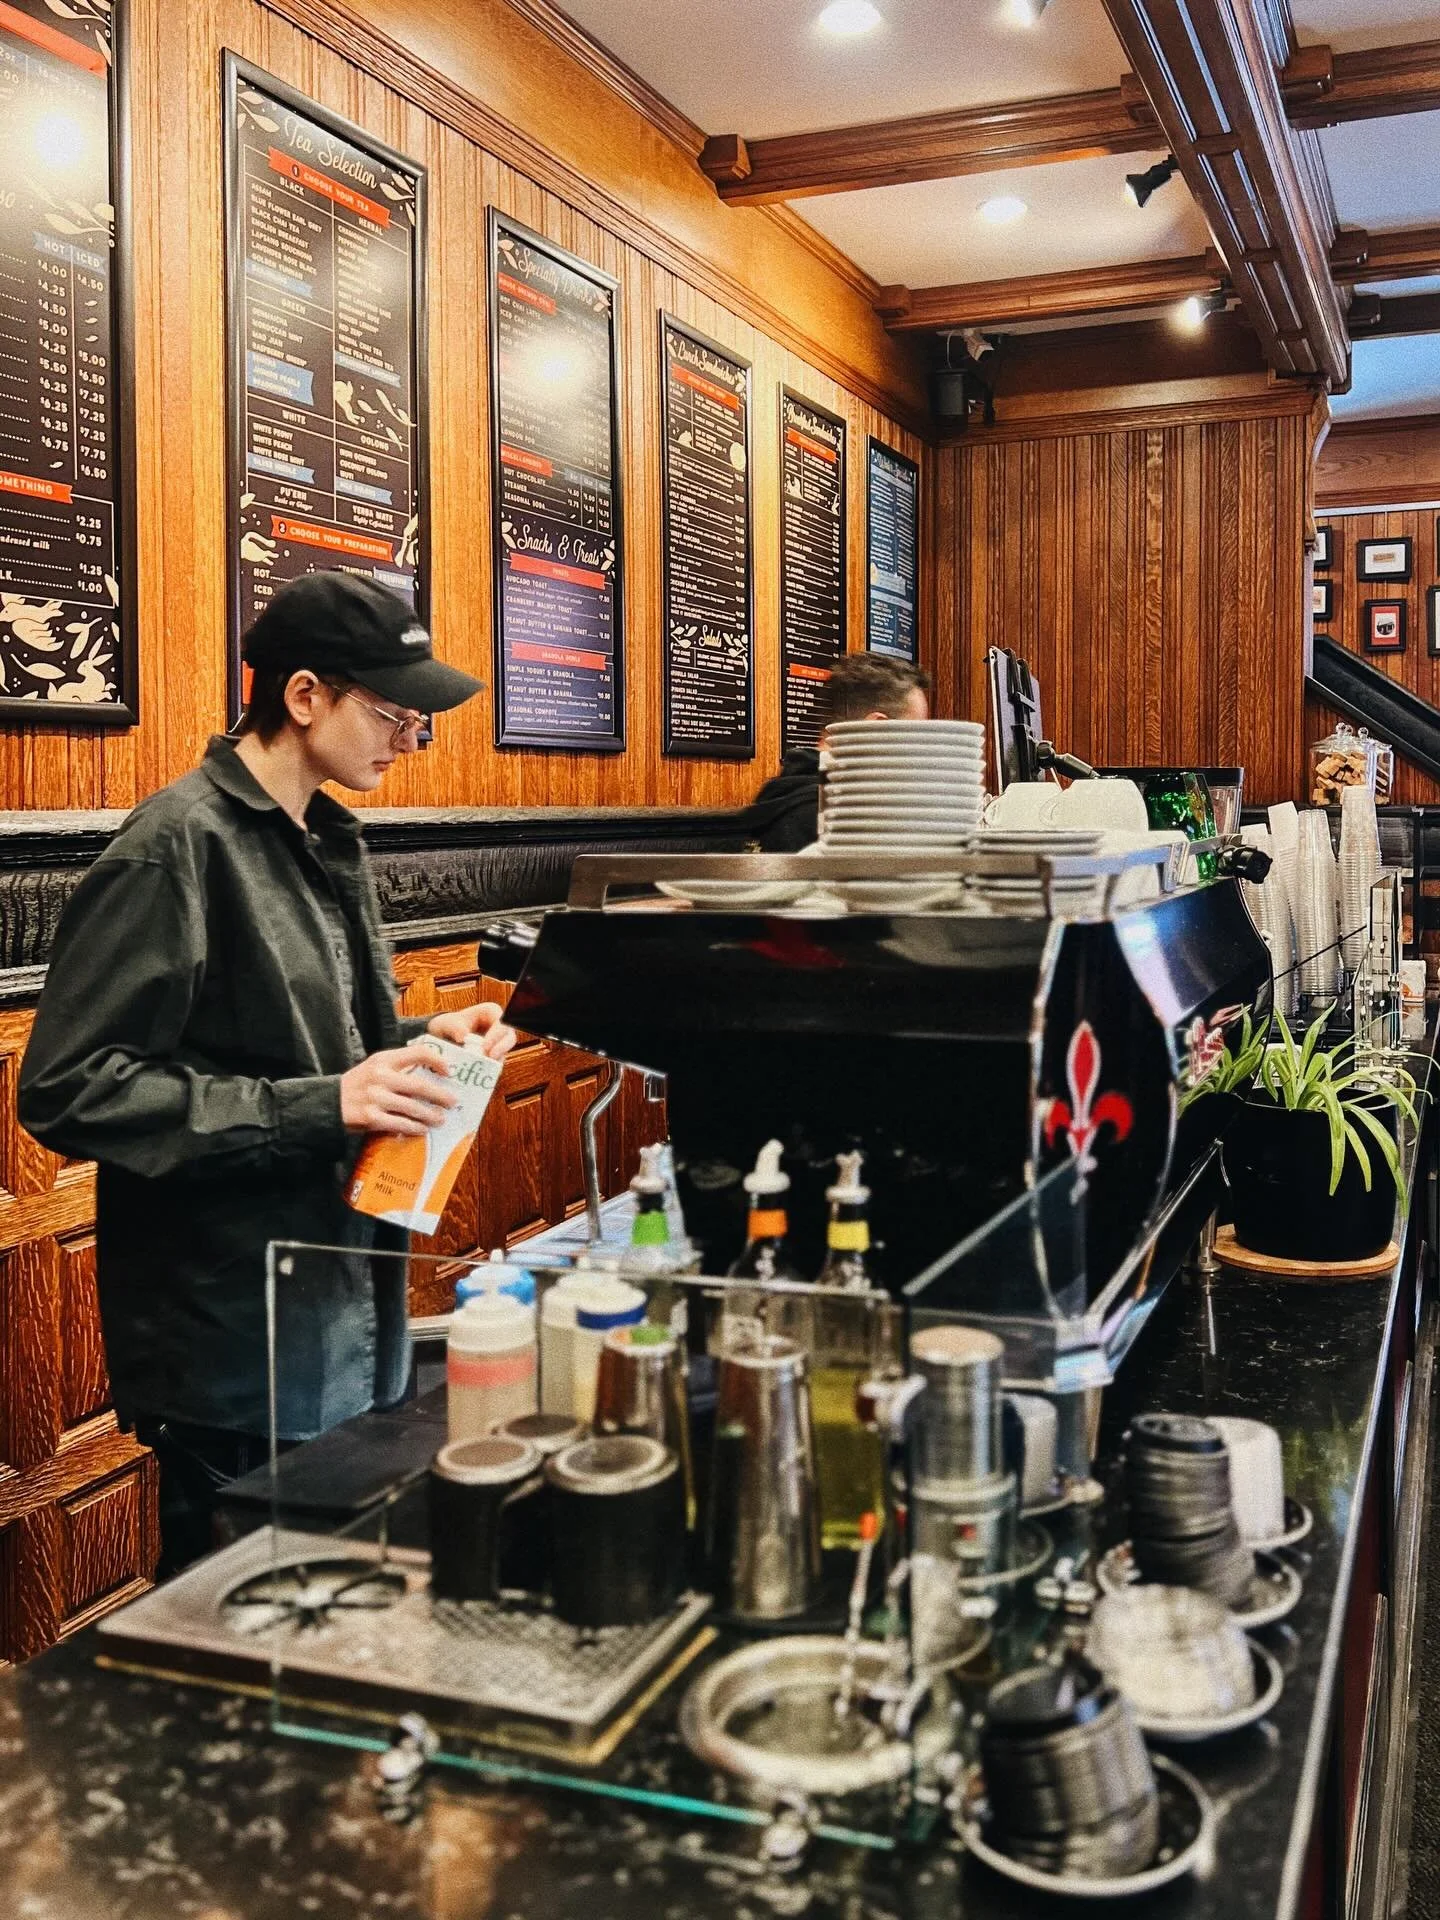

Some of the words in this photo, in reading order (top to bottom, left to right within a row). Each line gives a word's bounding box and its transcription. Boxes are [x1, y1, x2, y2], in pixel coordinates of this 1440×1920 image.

[284, 115, 314, 154] Tea
[318, 139, 377, 190] Selection
[251, 183, 272, 198] ASSAM
[280, 177, 305, 196] BLACK
[304, 173, 333, 193] CHOOSE
[336, 187, 354, 205] YOUR
[358, 201, 369, 212] TEA
[251, 194, 267, 208] BLUE
[267, 201, 291, 218] FLOWER
[292, 213, 307, 226] EARL
[251, 206, 271, 220] BLACK
[273, 216, 288, 228] CHAI
[288, 223, 300, 234] TEA
[359, 217, 383, 236] HERBAL
[251, 217, 277, 234] ENGLISH
[278, 229, 309, 249] BREAKFAST
[44, 240, 65, 254] HOT
[38, 259, 67, 278] $4.00
[77, 253, 100, 268] ICED
[518, 247, 560, 294] Specialty
[38, 279, 65, 297] $4.25
[77, 274, 104, 292] $4.50
[281, 298, 306, 315] GREEN
[512, 300, 524, 312] CHAI
[39, 318, 68, 336] $5.00
[39, 338, 67, 355] $4.25
[678, 341, 699, 367] Lunch
[79, 350, 106, 368] $5.00
[40, 377, 67, 394] $6.25
[79, 369, 106, 386] $6.50
[40, 396, 67, 413] $6.25
[79, 388, 105, 405] $7.25
[41, 416, 68, 432] $6.25
[282, 409, 306, 425] WHITE
[253, 422, 272, 434] WHITE
[41, 435, 69, 452] $6.75
[253, 433, 272, 446] WHITE
[273, 439, 293, 452] PEACH
[360, 435, 390, 451] OOLONG
[80, 445, 106, 461] $7.75
[253, 445, 272, 457] WHITE
[273, 451, 289, 462] ROSE
[81, 464, 107, 480] $6.50
[503, 467, 515, 476] HOT
[516, 471, 546, 486] CHOCOLATE
[504, 480, 527, 492] STEAMER
[504, 491, 531, 506] SEASONAL
[532, 500, 545, 510] SODA
[76, 515, 102, 529] $2.25
[353, 505, 374, 516] YERBA
[375, 510, 393, 523] MATE
[33, 541, 51, 550] milk
[76, 533, 102, 547] $0.75
[290, 526, 320, 541] CHOOSE
[323, 533, 342, 545] YOUR
[344, 538, 388, 555] PREPARATION
[517, 524, 553, 554] Snacks
[558, 535, 570, 560] &
[573, 538, 600, 566] Treats
[80, 563, 102, 576] $1.25
[253, 568, 270, 579] HOT
[78, 580, 102, 593] $1.00
[253, 584, 273, 596] ICED
[506, 574, 531, 585] AVOCADO
[532, 580, 548, 589] TOAST
[506, 595, 535, 607] CRANBERRY
[537, 601, 556, 611] WALNUT
[558, 605, 573, 614] TOAST
[506, 616, 526, 627] PEANUT
[527, 619, 546, 630] BUTTER
[553, 624, 572, 634] BANANA
[699, 625, 721, 648] Salads
[507, 664, 525, 674] SIMPLE
[527, 667, 545, 676] YOGURT
[553, 670, 575, 679] GRANOLA
[507, 686, 526, 694] PEANUT
[528, 688, 547, 696] BUTTER
[553, 690, 573, 698] BANANA
[507, 705, 533, 714] SEASONAL
[535, 707, 557, 716] COMPOTE
[378, 1171, 417, 1192] Almond
[374, 1183, 394, 1198] Milk
